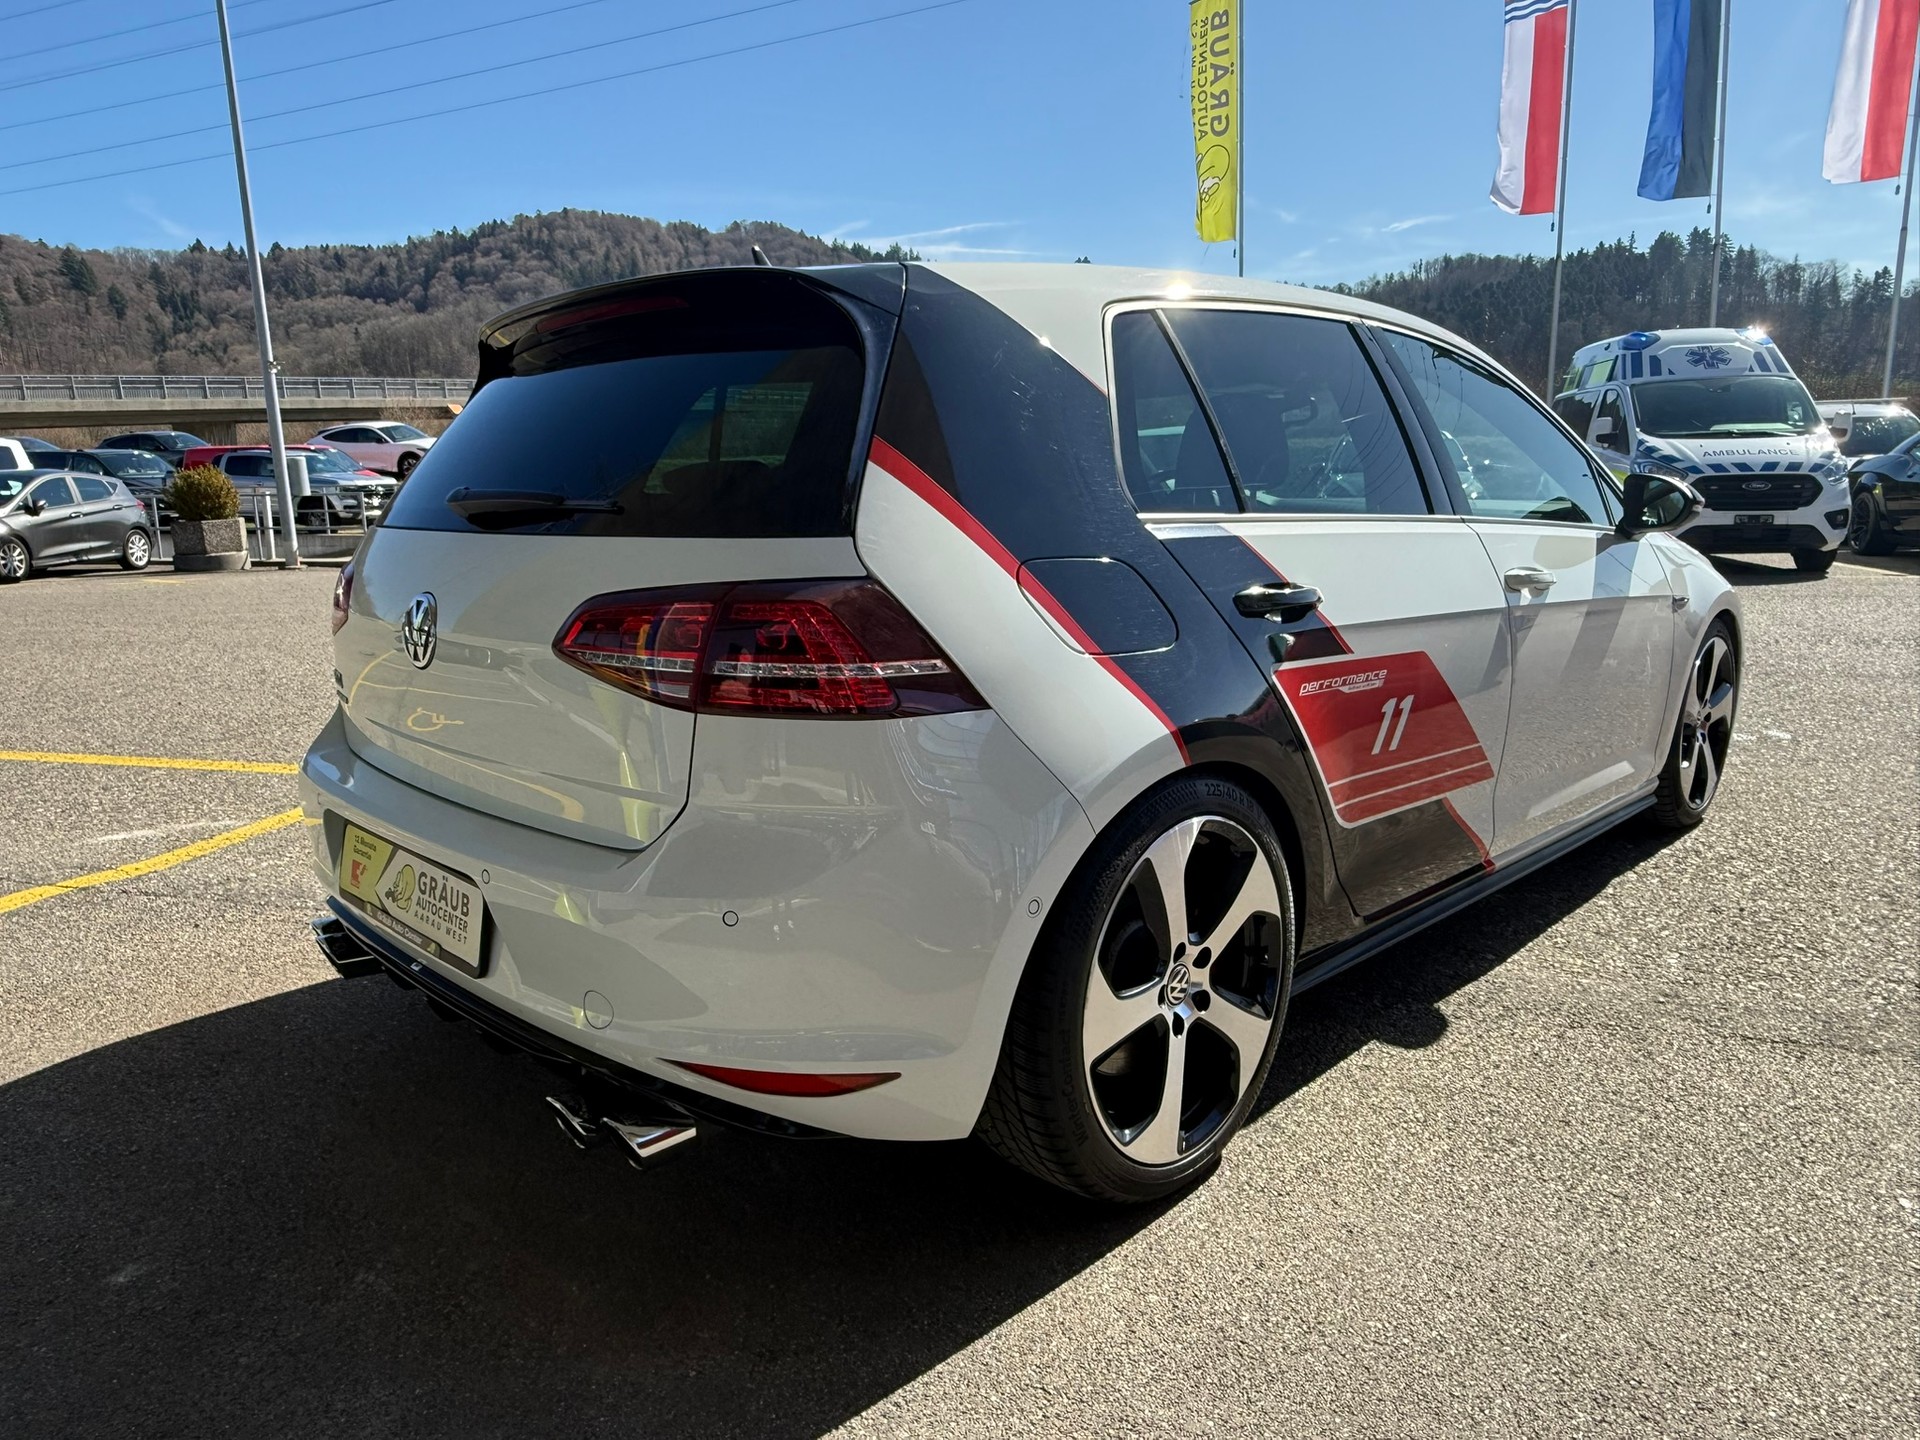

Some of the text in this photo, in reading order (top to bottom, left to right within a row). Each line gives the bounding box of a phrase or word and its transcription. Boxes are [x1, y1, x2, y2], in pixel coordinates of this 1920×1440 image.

[1703, 449, 1799, 457] AMBULANCE
[1299, 669, 1387, 696] performance
[1371, 694, 1415, 755] 11
[1205, 783, 1238, 801] 225/40
[418, 871, 470, 917] GRÄUB
[414, 910, 467, 945] AARAU WEST
[416, 896, 468, 934] AUTOCENTER
